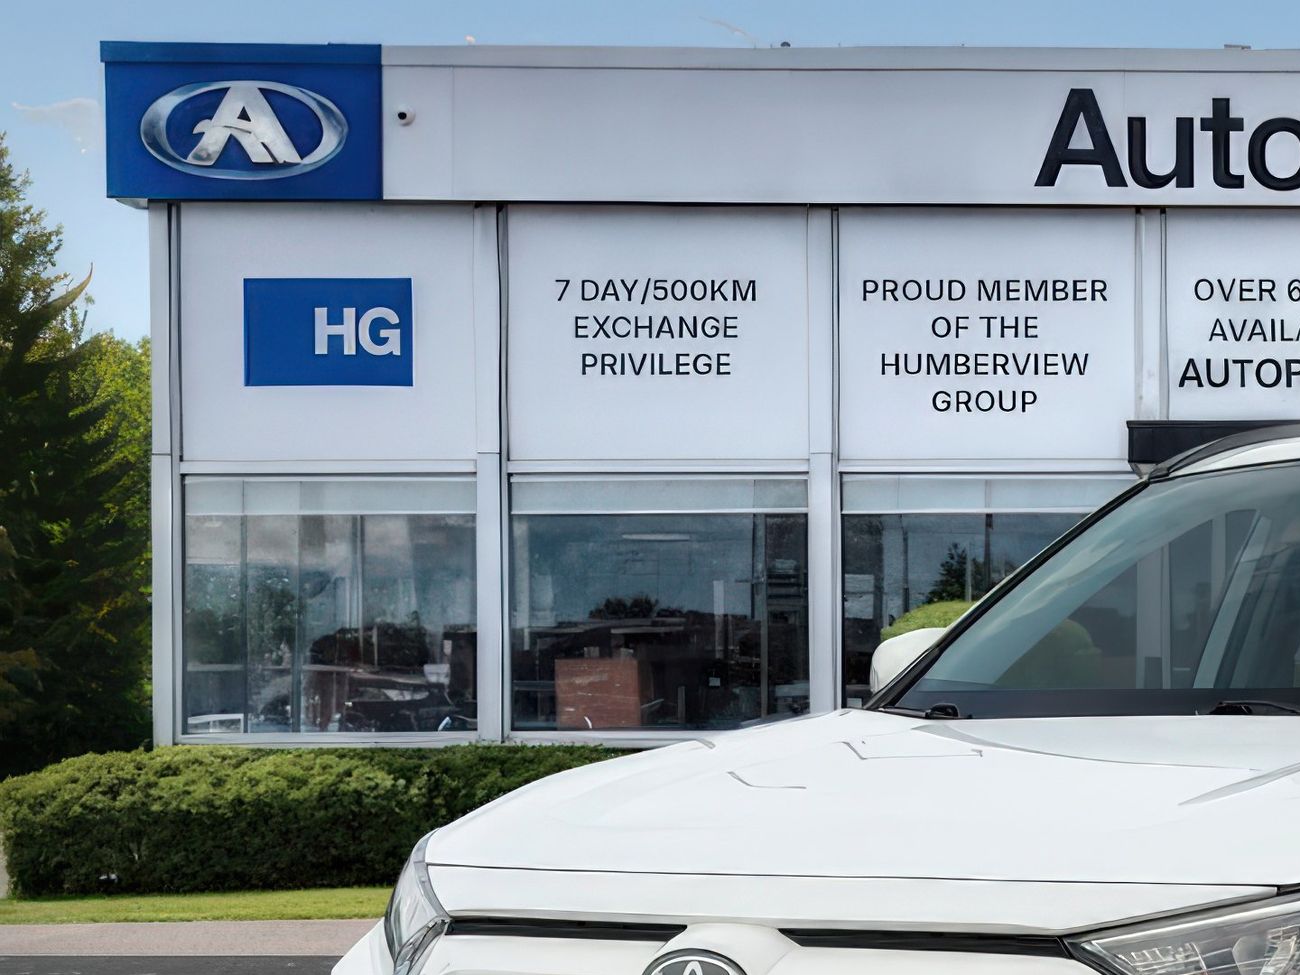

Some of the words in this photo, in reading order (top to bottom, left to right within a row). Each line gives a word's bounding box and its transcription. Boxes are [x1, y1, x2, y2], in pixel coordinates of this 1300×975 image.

[554, 279, 571, 302] 7
[580, 277, 757, 305] DAY/500KM
[862, 279, 966, 302] PROUD
[977, 279, 1108, 302] MEMBER
[1194, 278, 1277, 303] OVER
[314, 306, 401, 356] HG
[574, 315, 739, 340] EXCHANGE
[931, 315, 970, 339] OF
[978, 315, 1039, 339] THE
[581, 352, 731, 376] PRIVILEGE
[881, 352, 1089, 376] HUMBERVIEW
[931, 389, 1038, 413] GROUP
